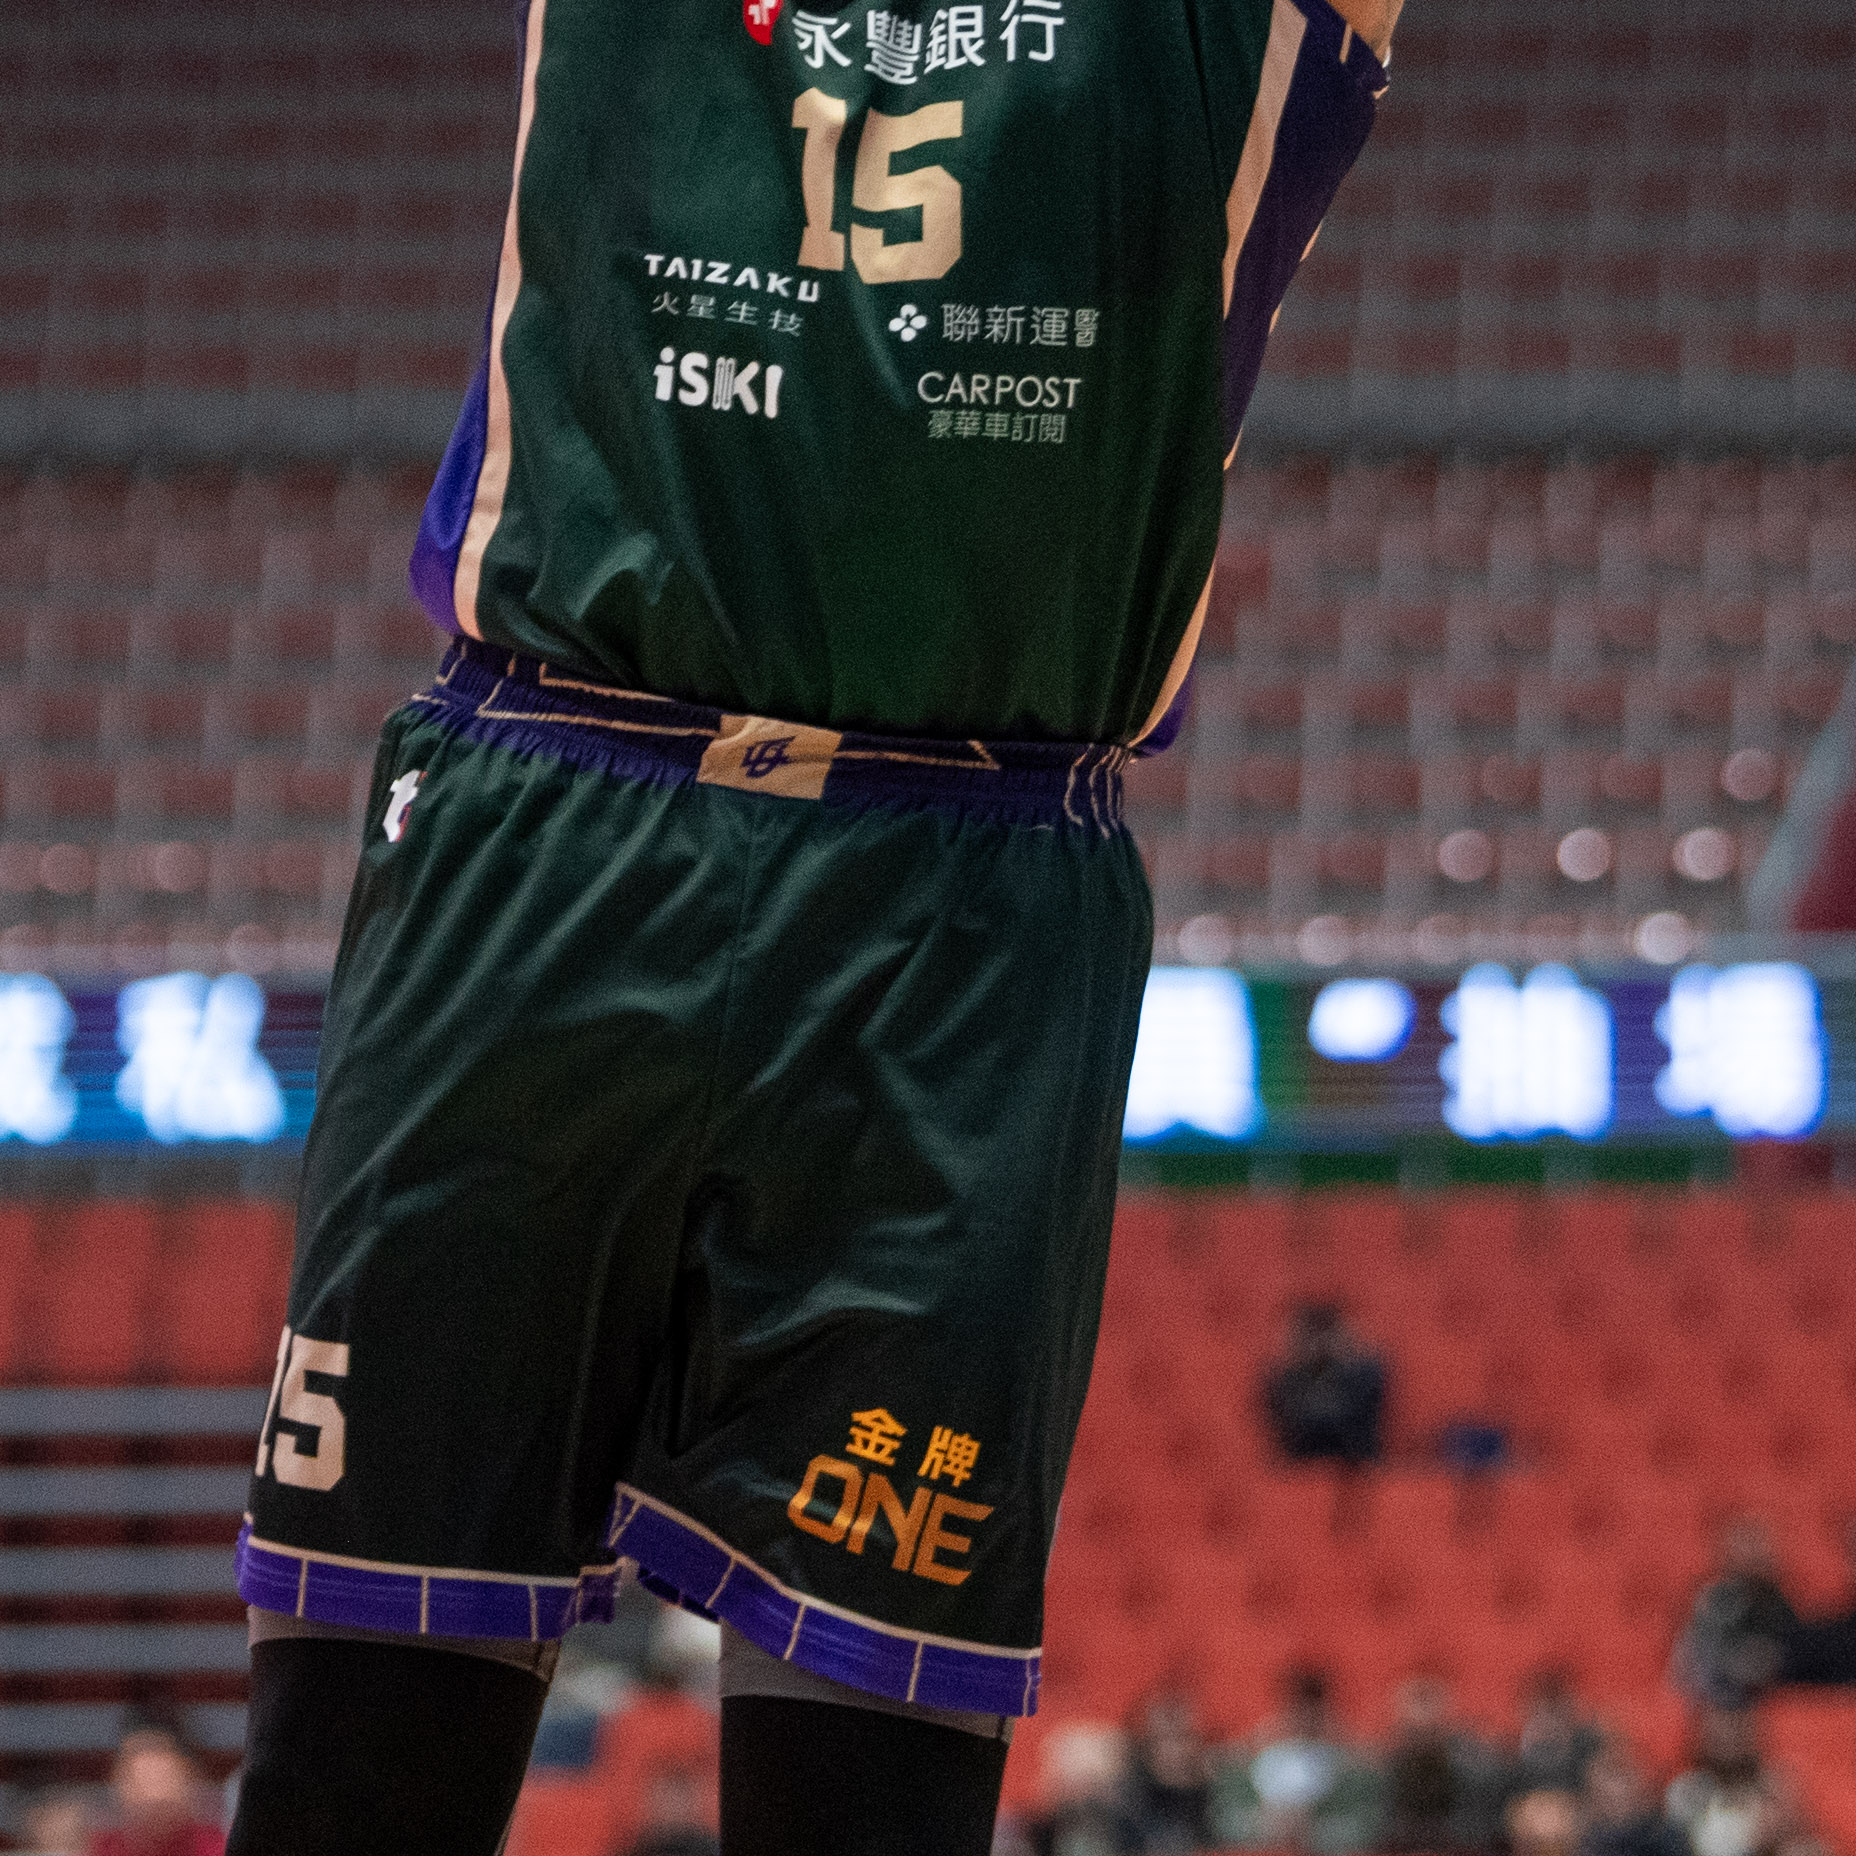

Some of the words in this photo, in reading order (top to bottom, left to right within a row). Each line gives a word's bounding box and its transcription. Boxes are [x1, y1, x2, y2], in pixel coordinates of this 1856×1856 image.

[792, 87, 963, 284] 15
[644, 254, 819, 303] TAIZAKU
[651, 291, 803, 337] 火星生技
[941, 303, 1100, 347] 聯新運醫
[918, 371, 1082, 408] CARPOST
[845, 1407, 982, 1487] 金牌
[787, 1453, 994, 1586] ONE
